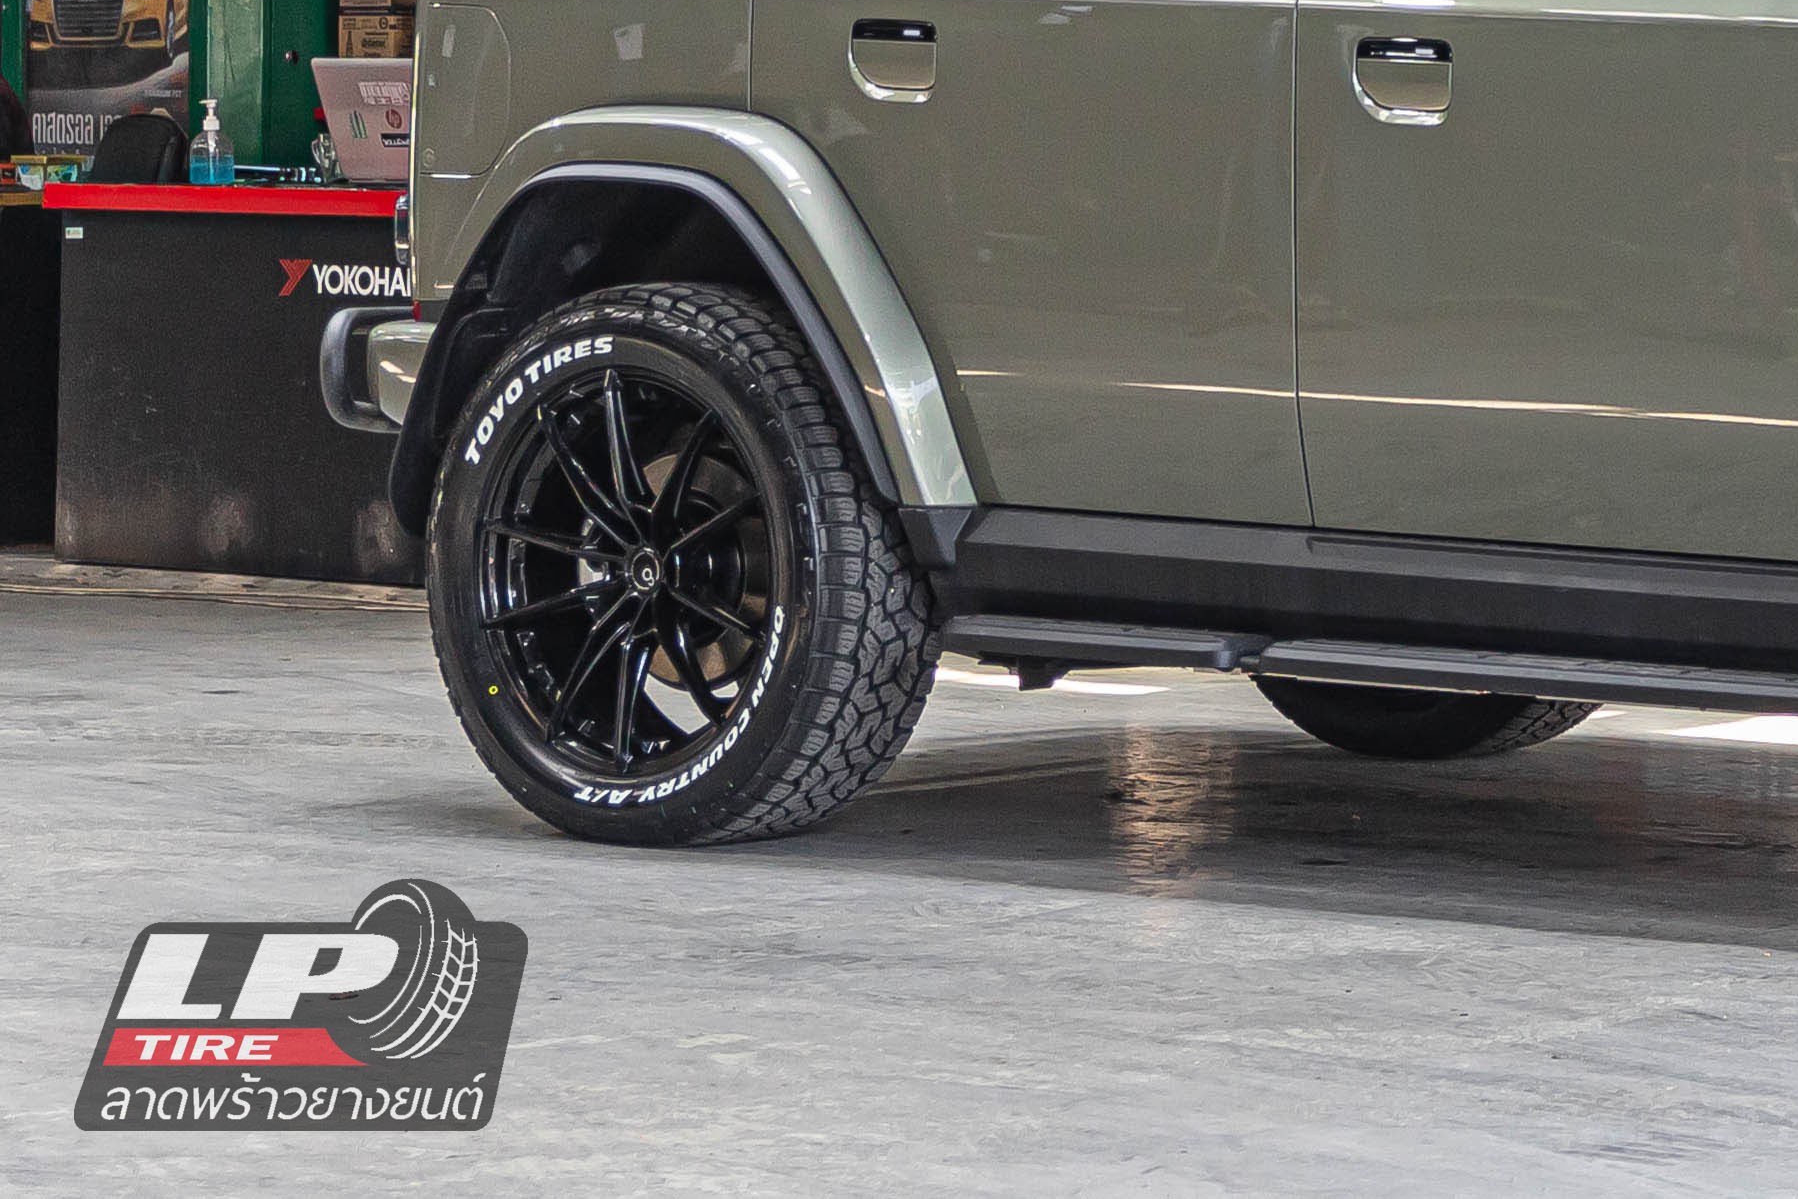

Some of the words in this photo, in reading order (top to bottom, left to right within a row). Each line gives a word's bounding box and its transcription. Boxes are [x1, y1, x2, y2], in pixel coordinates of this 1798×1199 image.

[31, 110, 95, 146] คาสตรอล
[312, 263, 411, 298] YOKOHA
[465, 375, 524, 466] TOYO
[524, 335, 616, 384] TIRES
[750, 604, 788, 708] OPEN
[637, 704, 753, 804] COUNTRY
[573, 784, 626, 805] A/T
